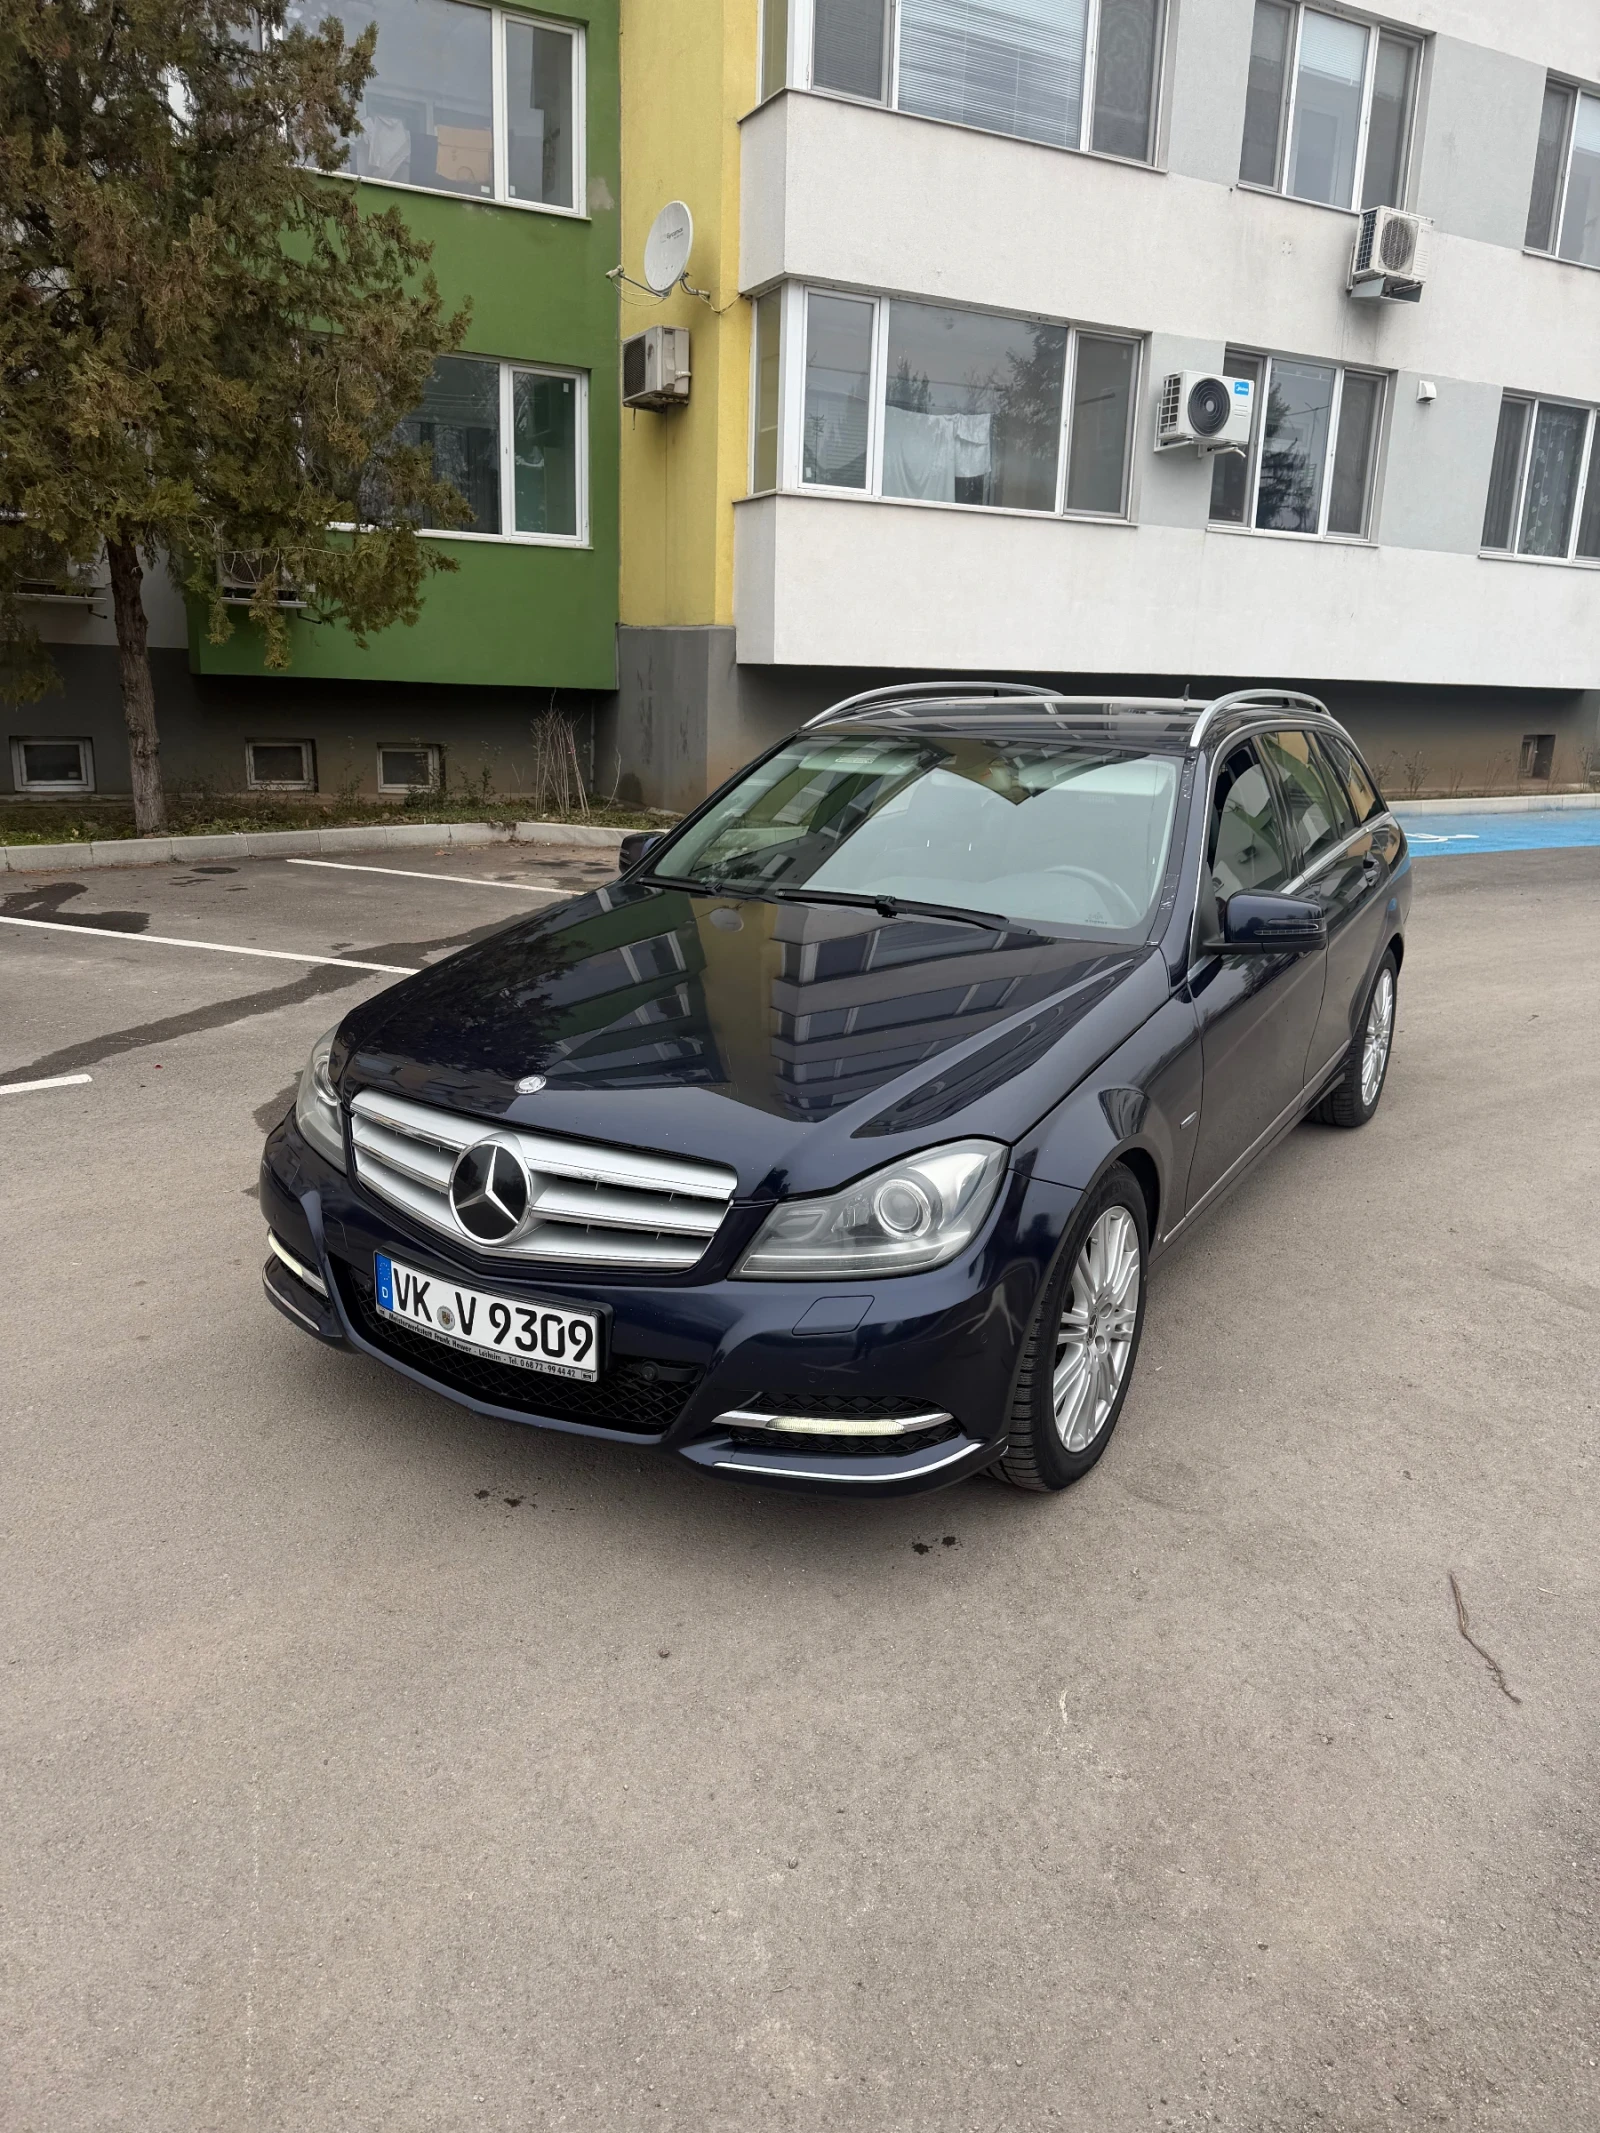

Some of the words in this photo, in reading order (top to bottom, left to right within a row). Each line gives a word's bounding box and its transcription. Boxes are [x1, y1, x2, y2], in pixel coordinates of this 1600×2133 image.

[382, 1286, 389, 1298] D
[393, 1267, 432, 1322] VK
[455, 1291, 476, 1335] V
[489, 1303, 593, 1362] 9309
